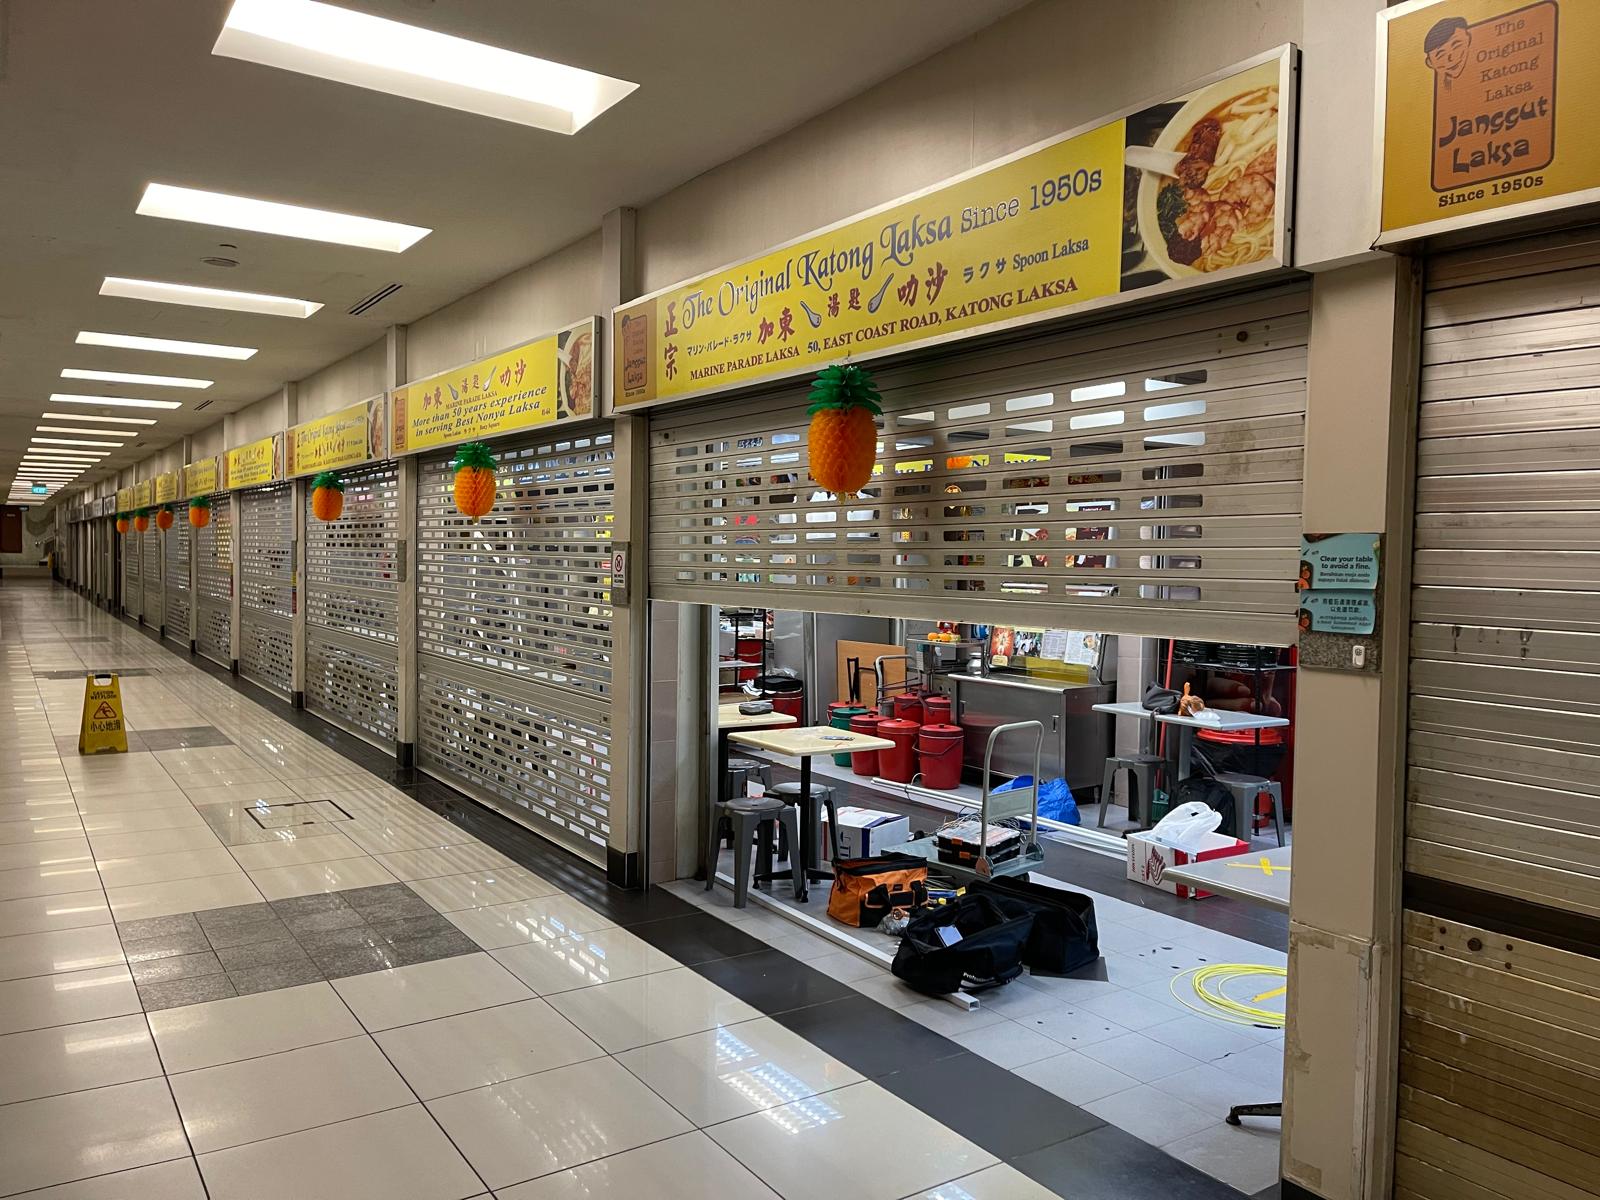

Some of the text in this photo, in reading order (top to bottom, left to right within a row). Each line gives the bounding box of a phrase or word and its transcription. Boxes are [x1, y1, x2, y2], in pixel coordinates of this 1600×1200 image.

[1494, 18, 1525, 37] The
[1476, 32, 1544, 63] Original
[1480, 55, 1539, 84] Katong
[1484, 80, 1533, 103] Laksa
[1439, 96, 1549, 148] Janggut
[1452, 138, 1530, 173] Laksa
[1438, 175, 1544, 208] Since 1950s
[682, 168, 1102, 330] The Original Katong Laksa Since 1950s
[1012, 238, 1089, 272] Spoon Laksa
[963, 257, 1007, 283] ラクサ
[757, 262, 949, 345] 加東 湯匙 叻沙
[807, 277, 1078, 354] 50, EAST COAST ROAD, KATONG LAKSA
[664, 301, 679, 381] 正宗
[690, 345, 800, 381] MARINE PARADE LAKSA
[412, 386, 547, 427] More than 50 years experience
[481, 390, 498, 400] LAKSA
[416, 428, 423, 437] in
[425, 422, 453, 432] serving
[456, 416, 474, 428] Best
[476, 409, 506, 423] Nonya
[509, 401, 541, 415] Laksa
